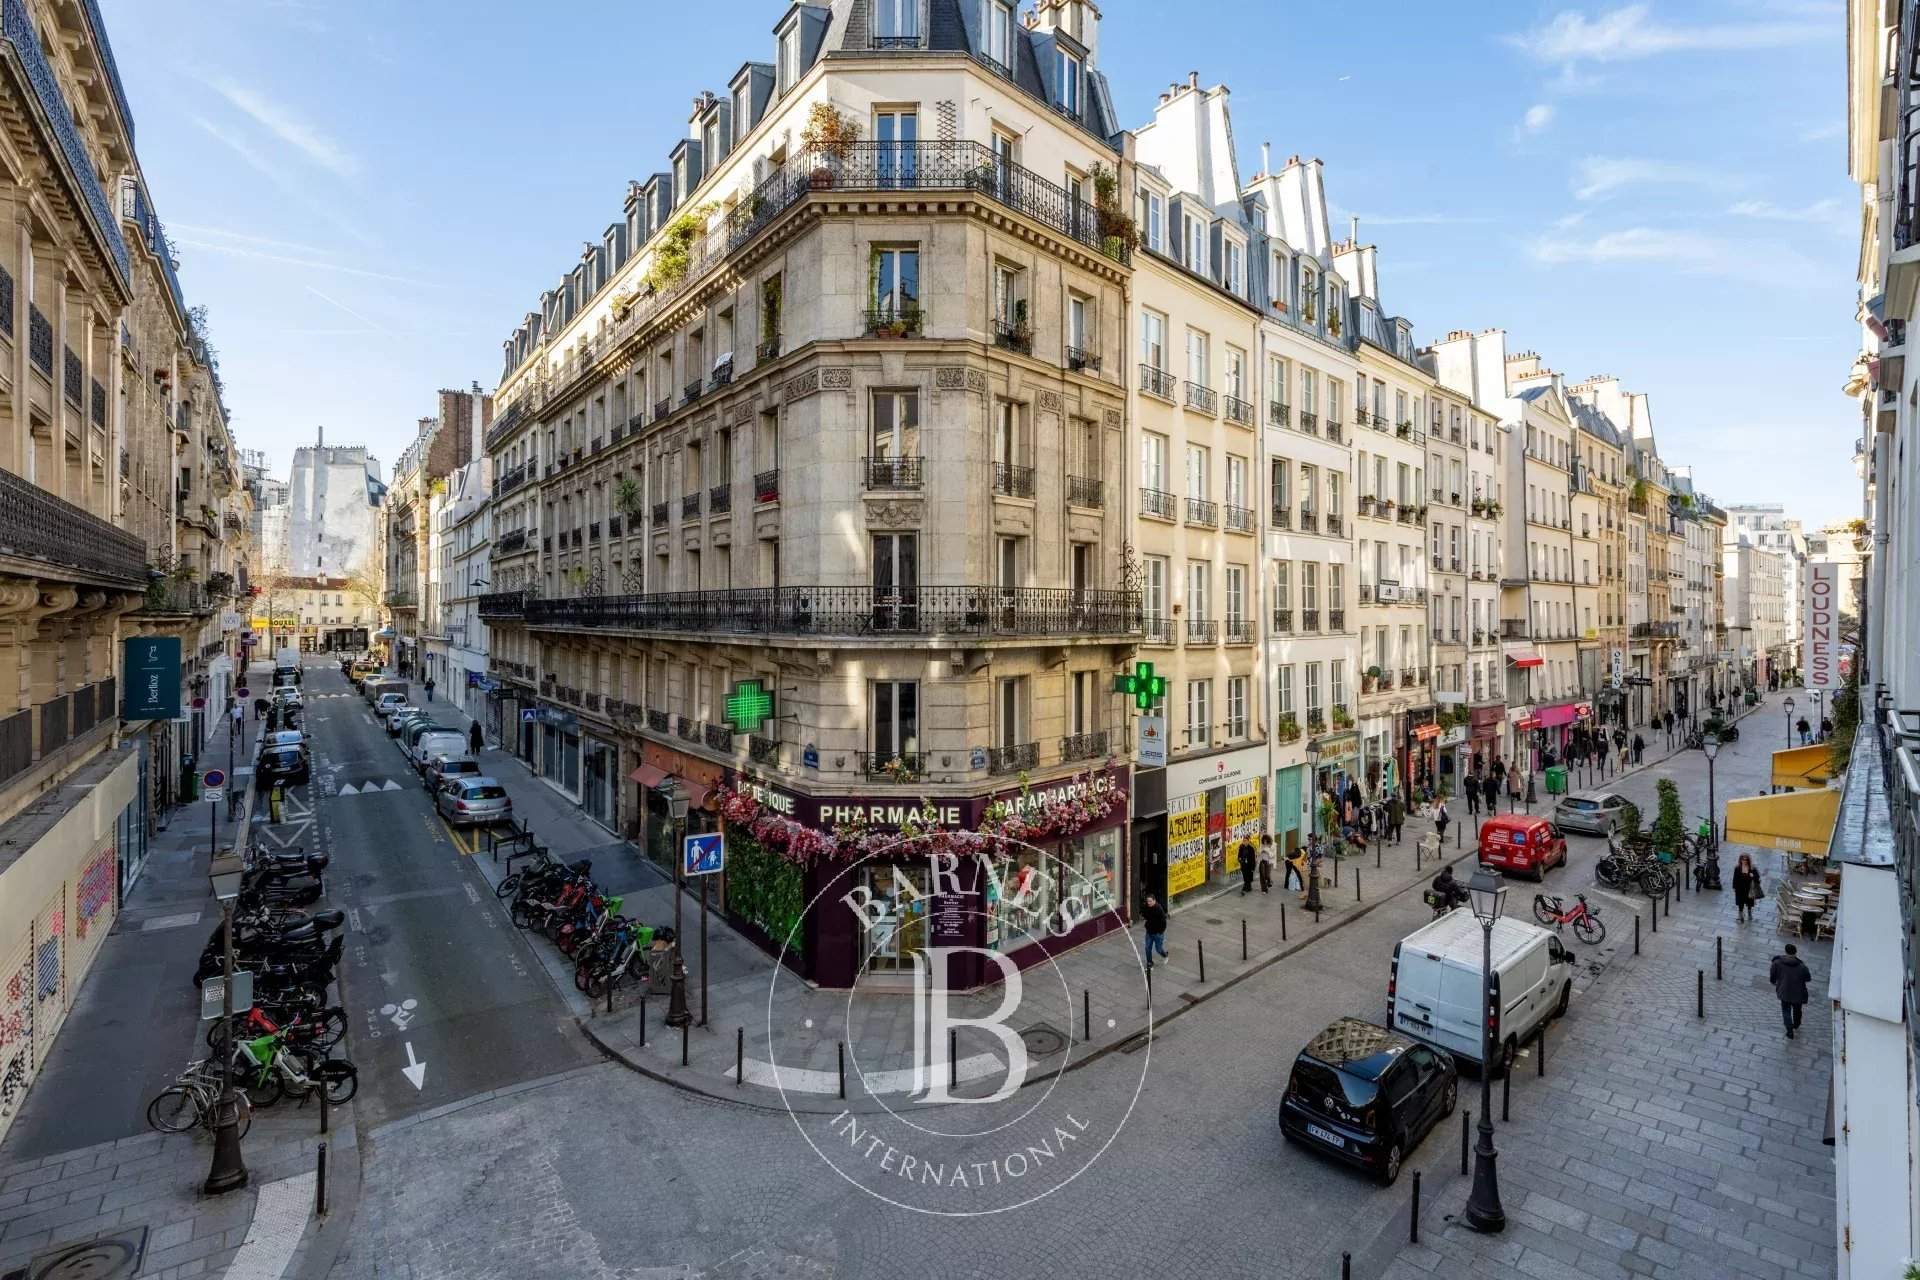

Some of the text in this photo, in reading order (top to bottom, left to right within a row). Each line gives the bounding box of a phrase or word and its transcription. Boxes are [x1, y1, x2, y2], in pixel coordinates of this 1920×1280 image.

[1811, 567, 1831, 685] LOUDNESS
[147, 674, 159, 703] Berlioz
[820, 805, 961, 825] PHARMACIE
[1236, 796, 1257, 818] LOUER
